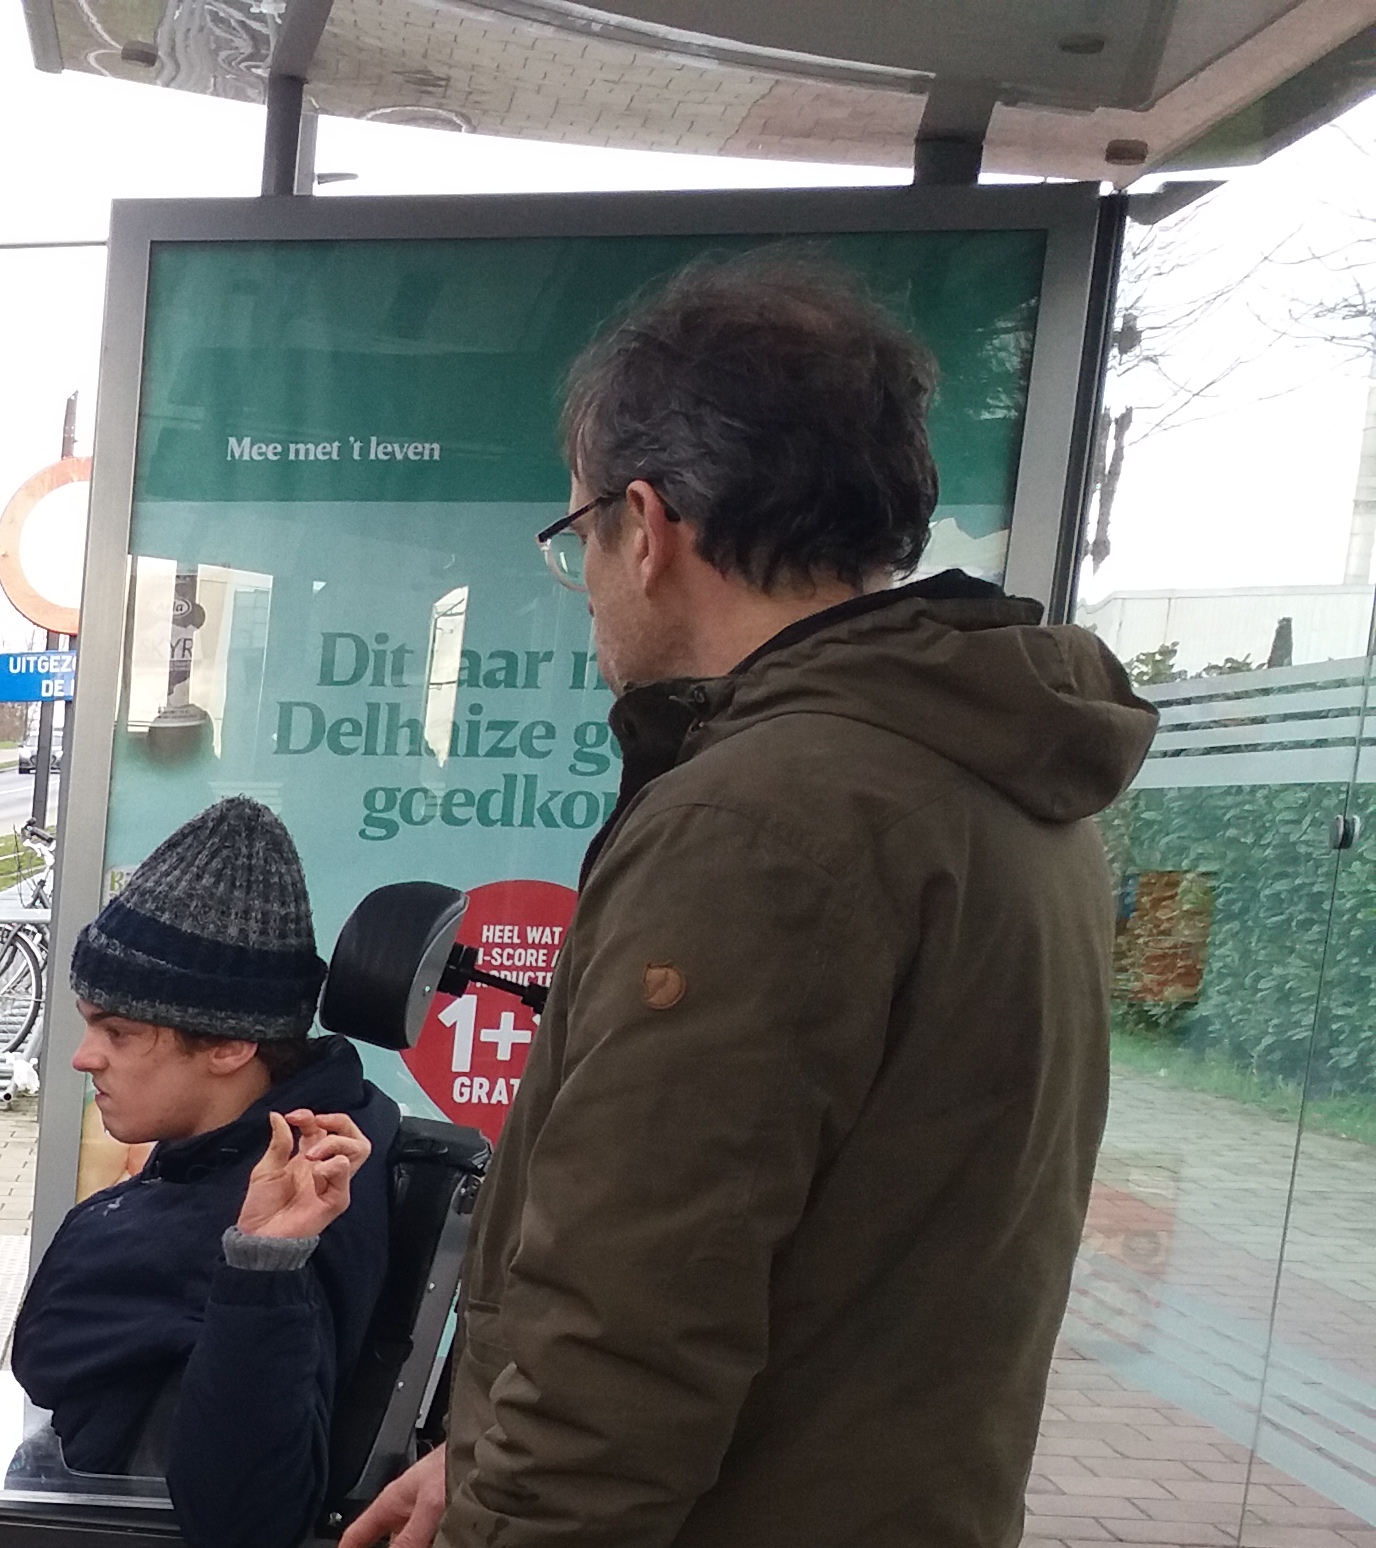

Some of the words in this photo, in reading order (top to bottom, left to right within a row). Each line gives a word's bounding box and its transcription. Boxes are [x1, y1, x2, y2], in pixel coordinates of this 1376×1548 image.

[226, 436, 282, 461] Mee
[288, 440, 341, 461] met
[369, 436, 441, 461] leven
[317, 631, 414, 688] Dit
[446, 648, 555, 690] aar
[41, 679, 65, 698] DE
[481, 924, 521, 944] HEEL
[526, 926, 563, 945] WAT
[477, 947, 548, 968] I-SCORE
[437, 994, 541, 1073] 1+
[452, 1076, 521, 1105] GRAT
